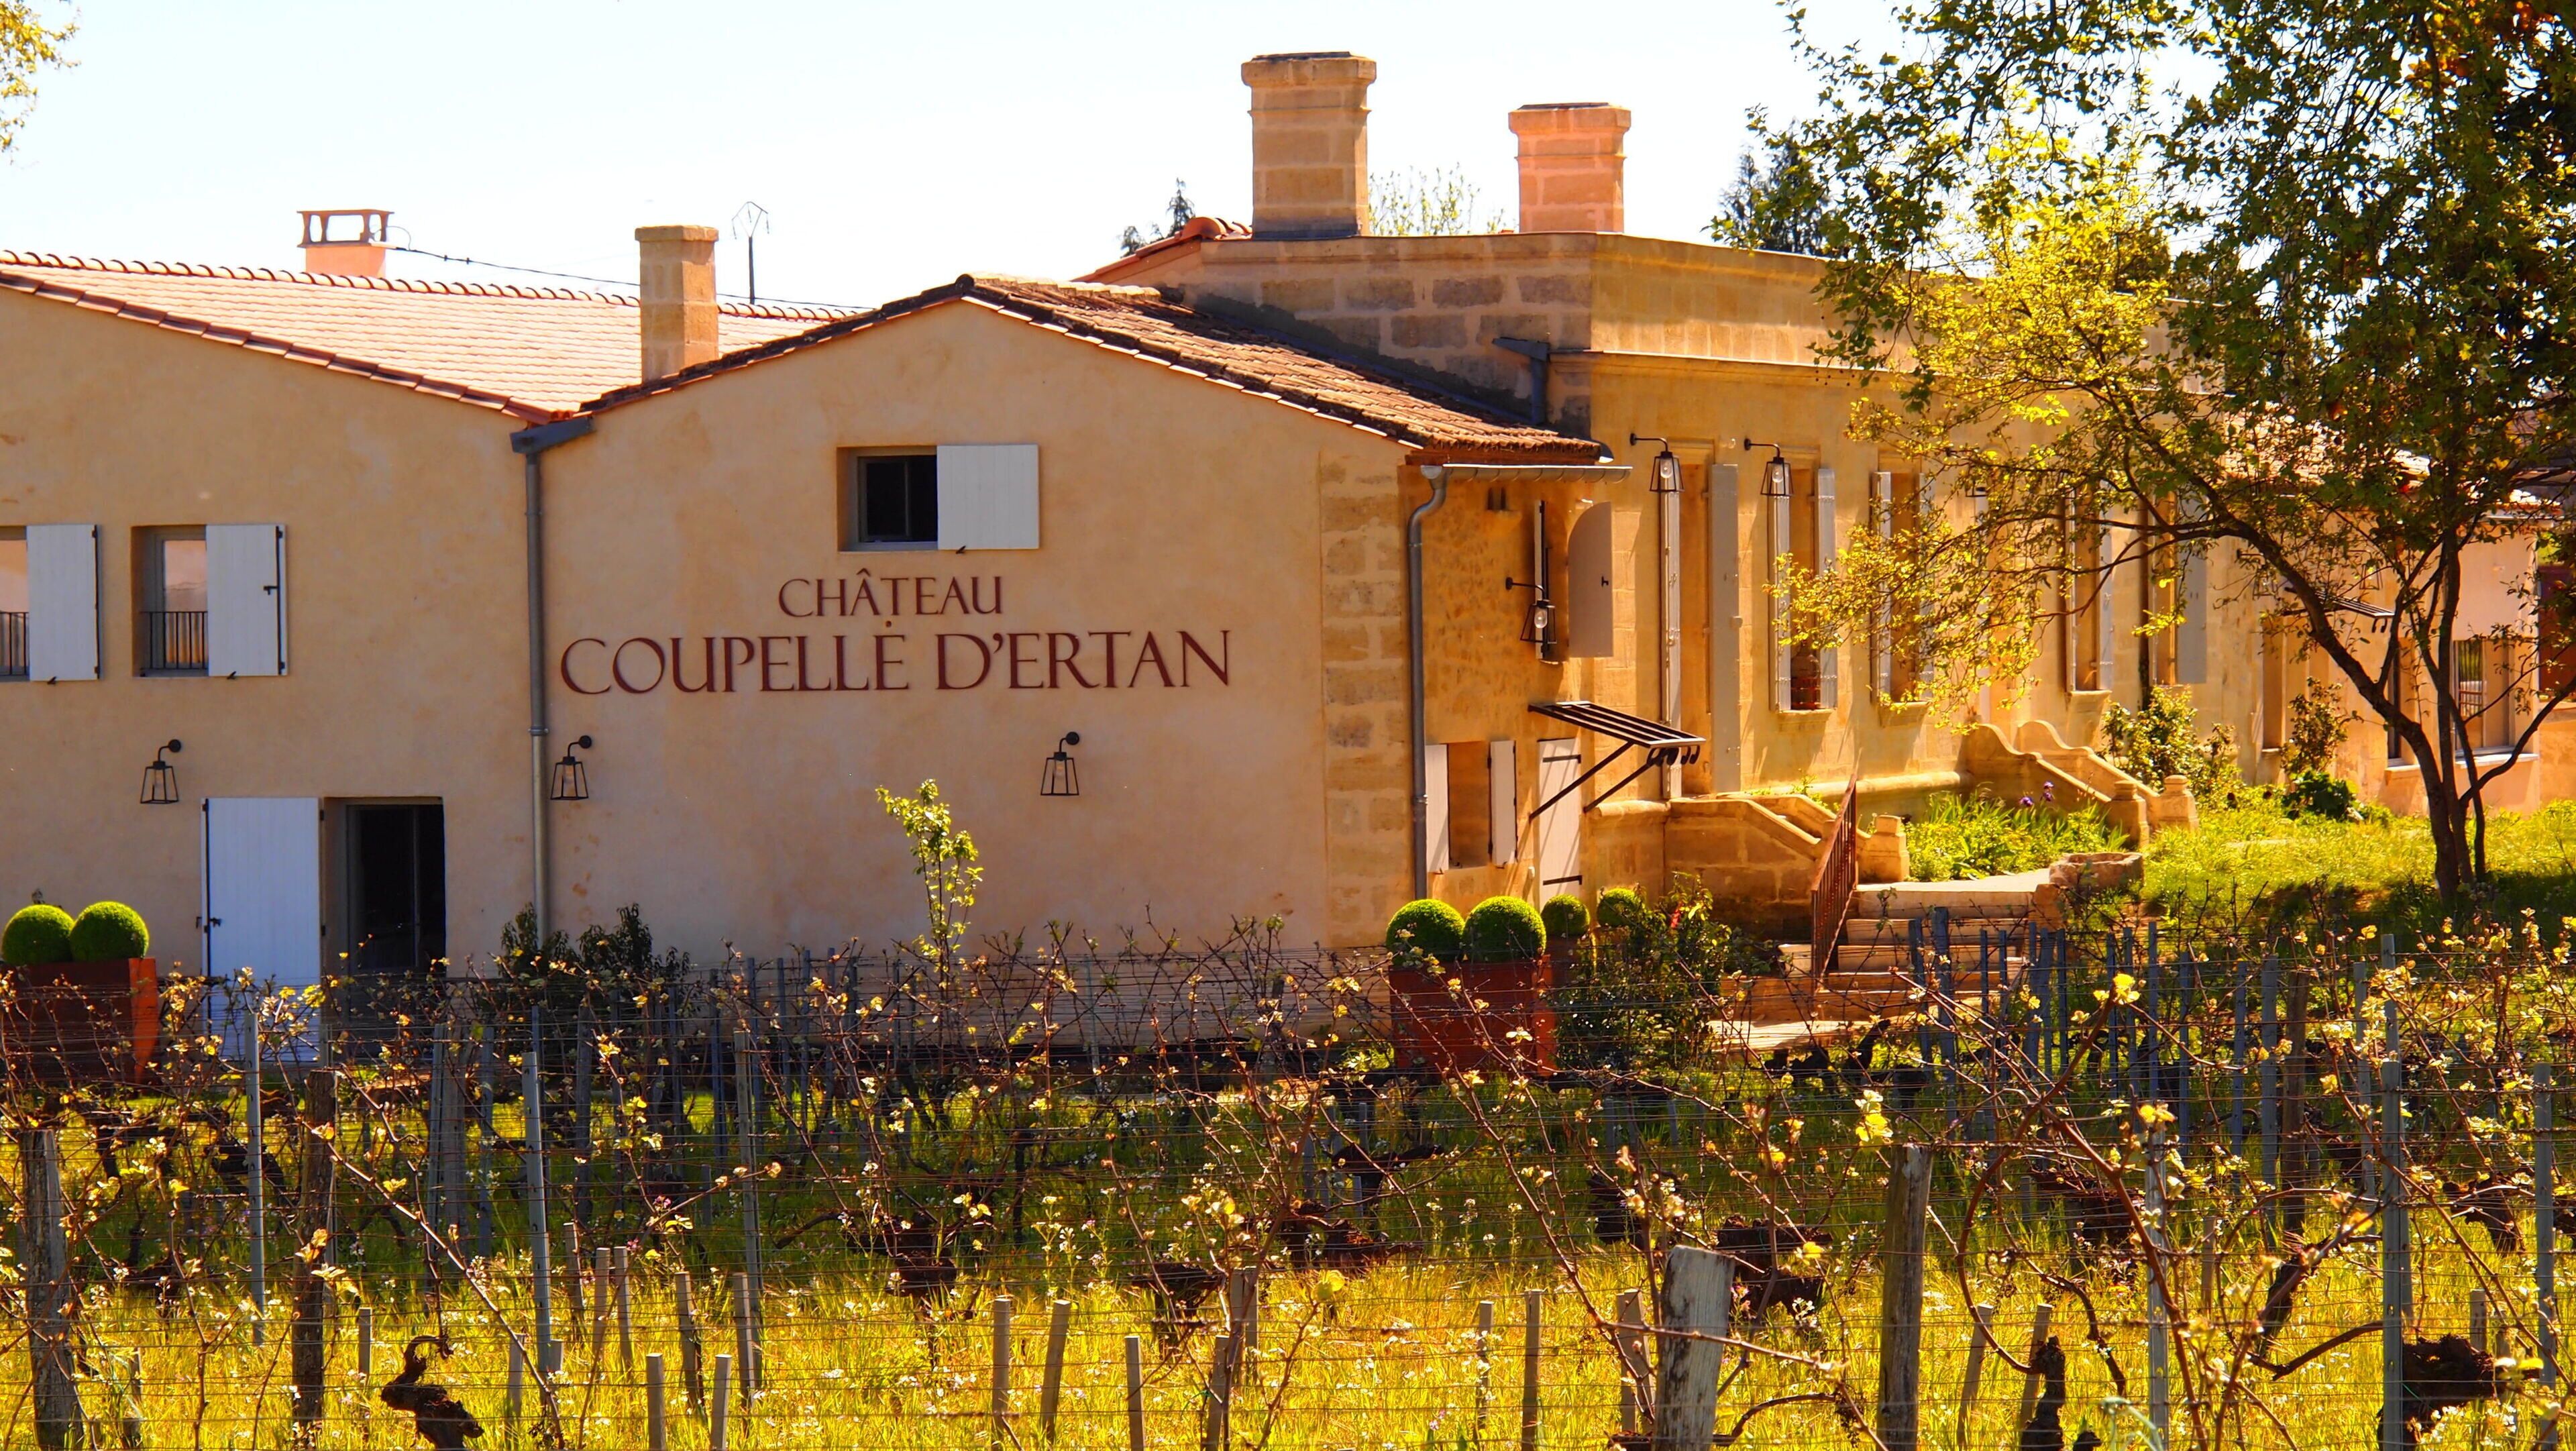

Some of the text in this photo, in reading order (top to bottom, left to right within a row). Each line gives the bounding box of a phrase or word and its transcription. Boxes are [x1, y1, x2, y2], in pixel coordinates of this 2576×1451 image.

[778, 568, 1003, 618] CHÂTEAU
[561, 630, 1231, 694] COUPELLE D'ERTAN
